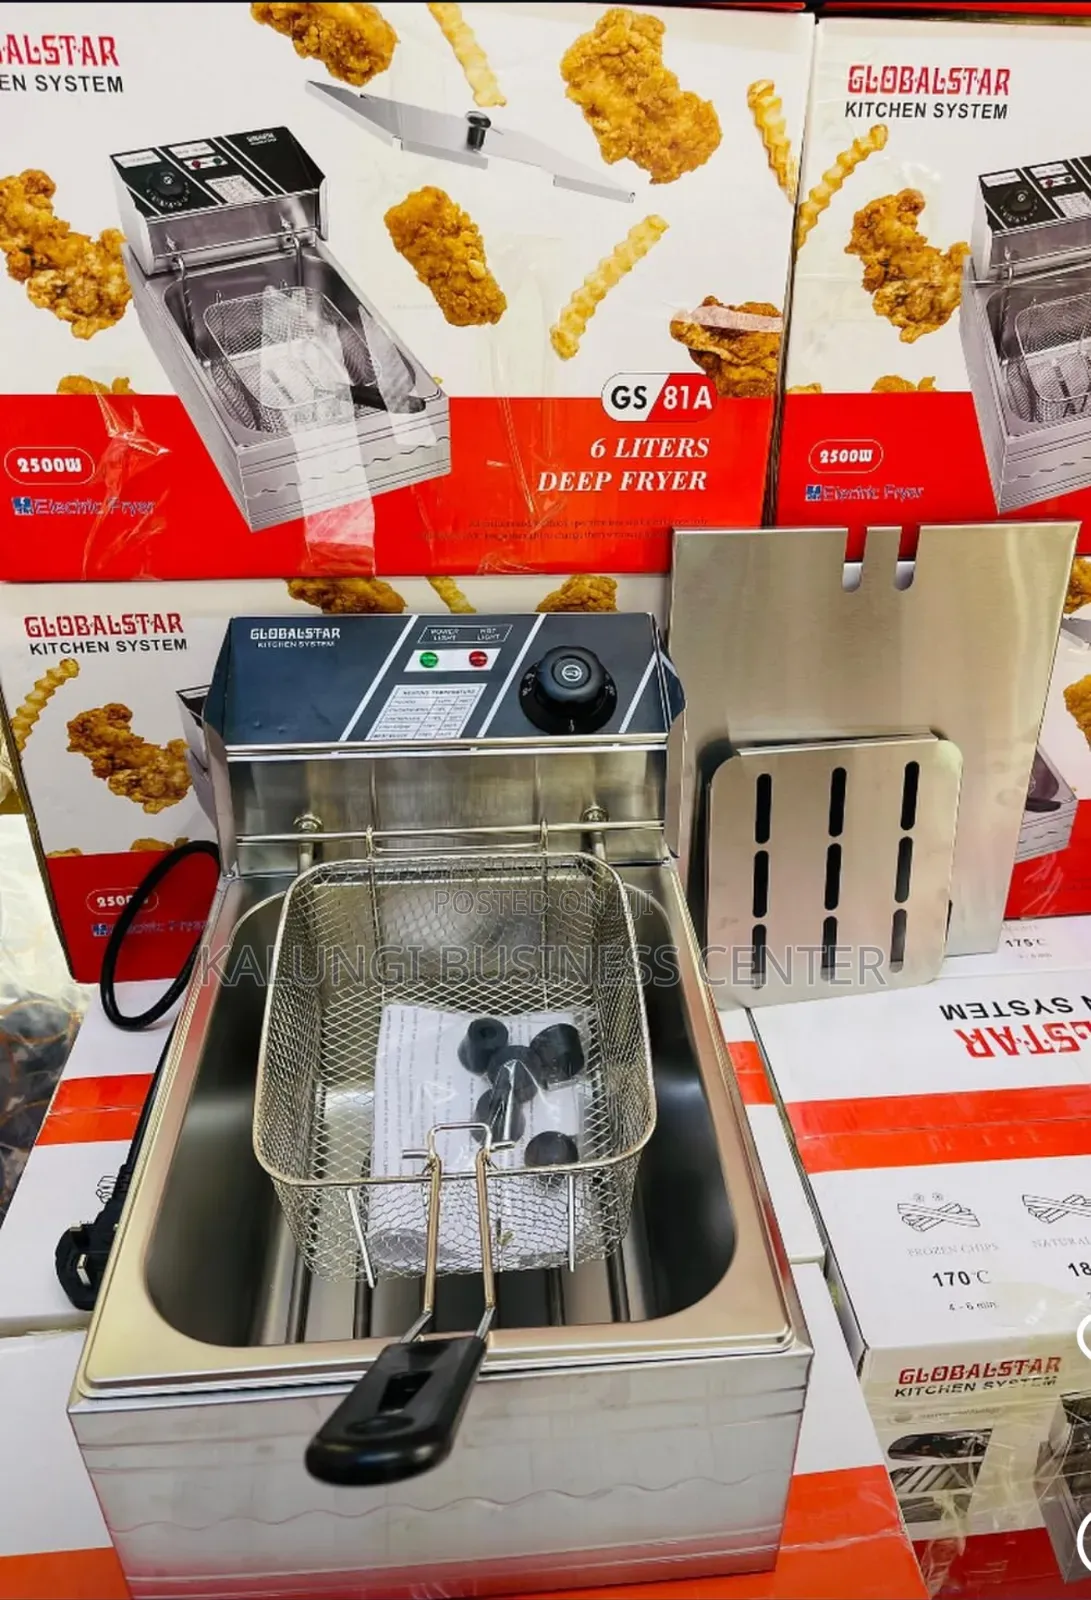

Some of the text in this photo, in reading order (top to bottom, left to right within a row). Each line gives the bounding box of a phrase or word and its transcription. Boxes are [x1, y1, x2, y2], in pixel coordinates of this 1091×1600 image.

[0, 34, 120, 66] ALSTAR
[35, 74, 124, 93] SYSTEM
[847, 65, 1011, 96] GLOBALSTAR
[845, 102, 1008, 119] KITCHEN SYSTEM
[611, 385, 713, 410] GS 81A
[590, 437, 710, 459] 6 LITERS
[820, 449, 873, 464] 2500W
[17, 457, 82, 473] 2500W
[537, 470, 708, 492] DEEP FRYER
[34, 498, 104, 515] Electric
[24, 613, 184, 638] GLOBALSTAR
[250, 627, 341, 640] GLOBALSTAR
[29, 638, 188, 656] KITCHEN SYSTEM
[257, 640, 335, 649] KITCHEN SYSTEM
[96, 894, 150, 908] 250
[939, 997, 1074, 1021] SYSTEM
[908, 1242, 1000, 1257] FROZEN CHIPS
[898, 1356, 1062, 1385] GLOBALSTAR
[894, 1382, 976, 1398] KITCHEN
